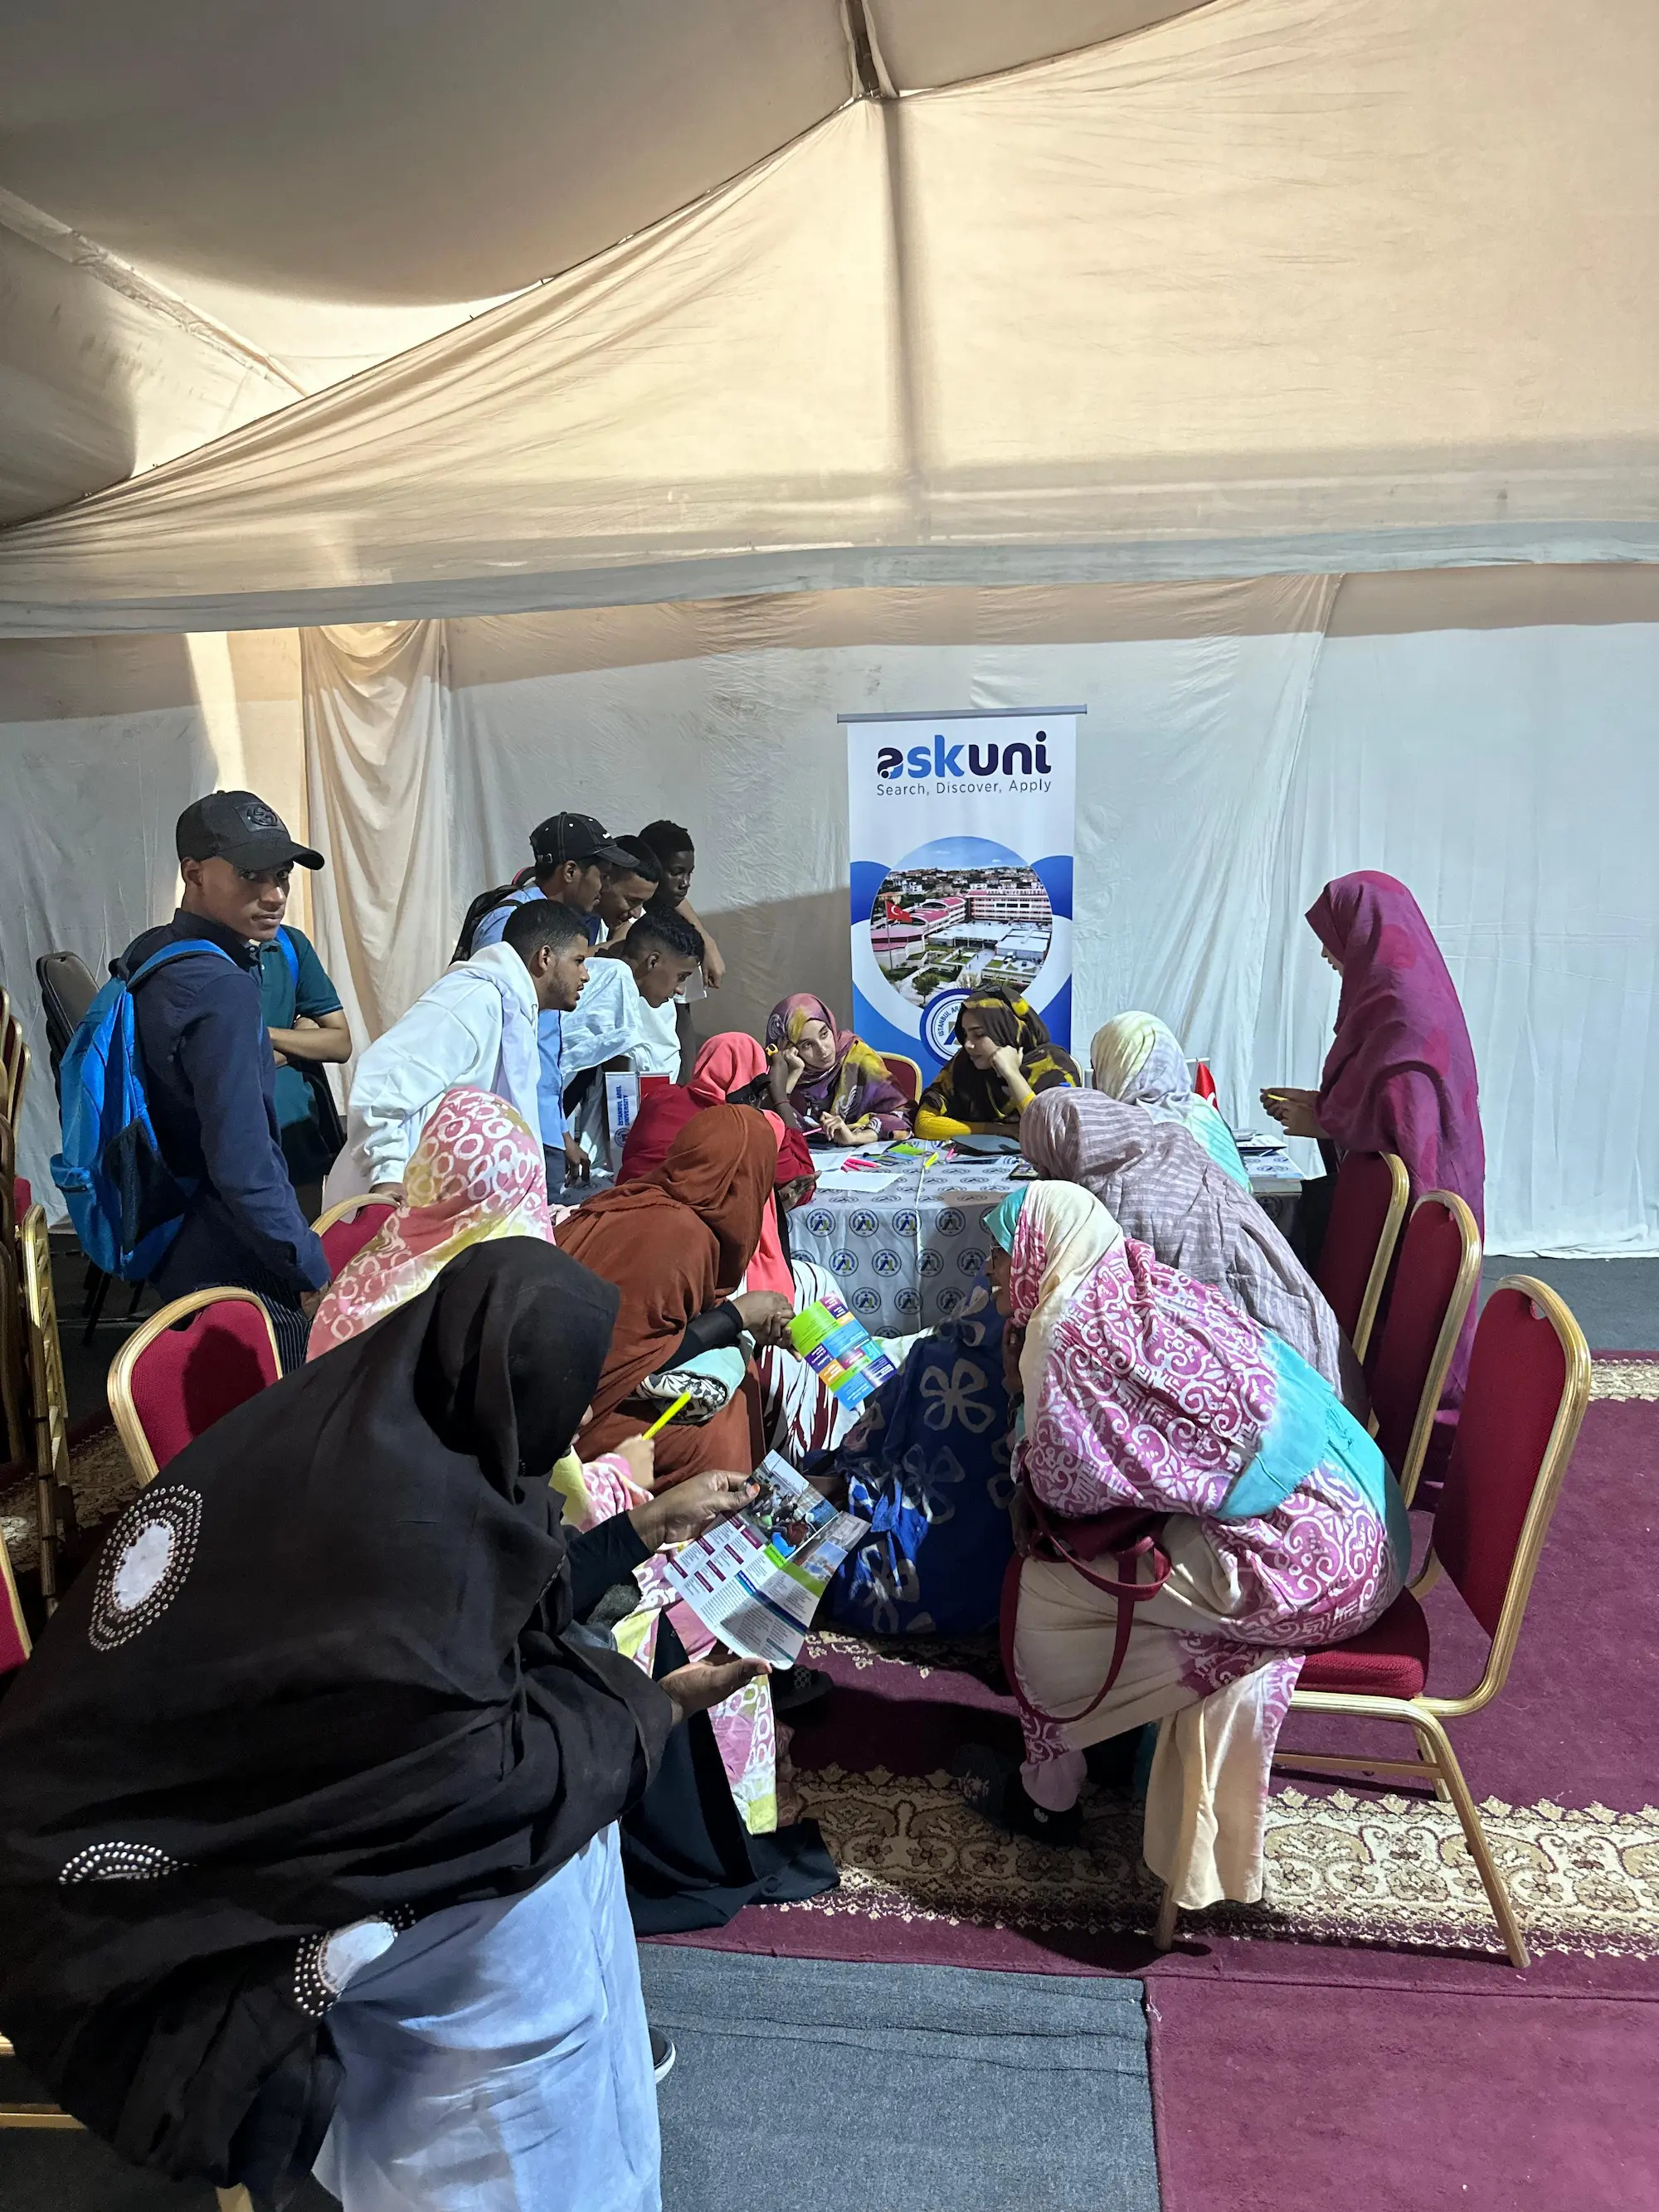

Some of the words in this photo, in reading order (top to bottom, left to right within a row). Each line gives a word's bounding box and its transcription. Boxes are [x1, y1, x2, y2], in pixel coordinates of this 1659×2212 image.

[877, 730, 1052, 780] askuni
[877, 783, 930, 796] Search,
[937, 781, 1002, 795] Discover,
[1009, 778, 1052, 792] Apply
